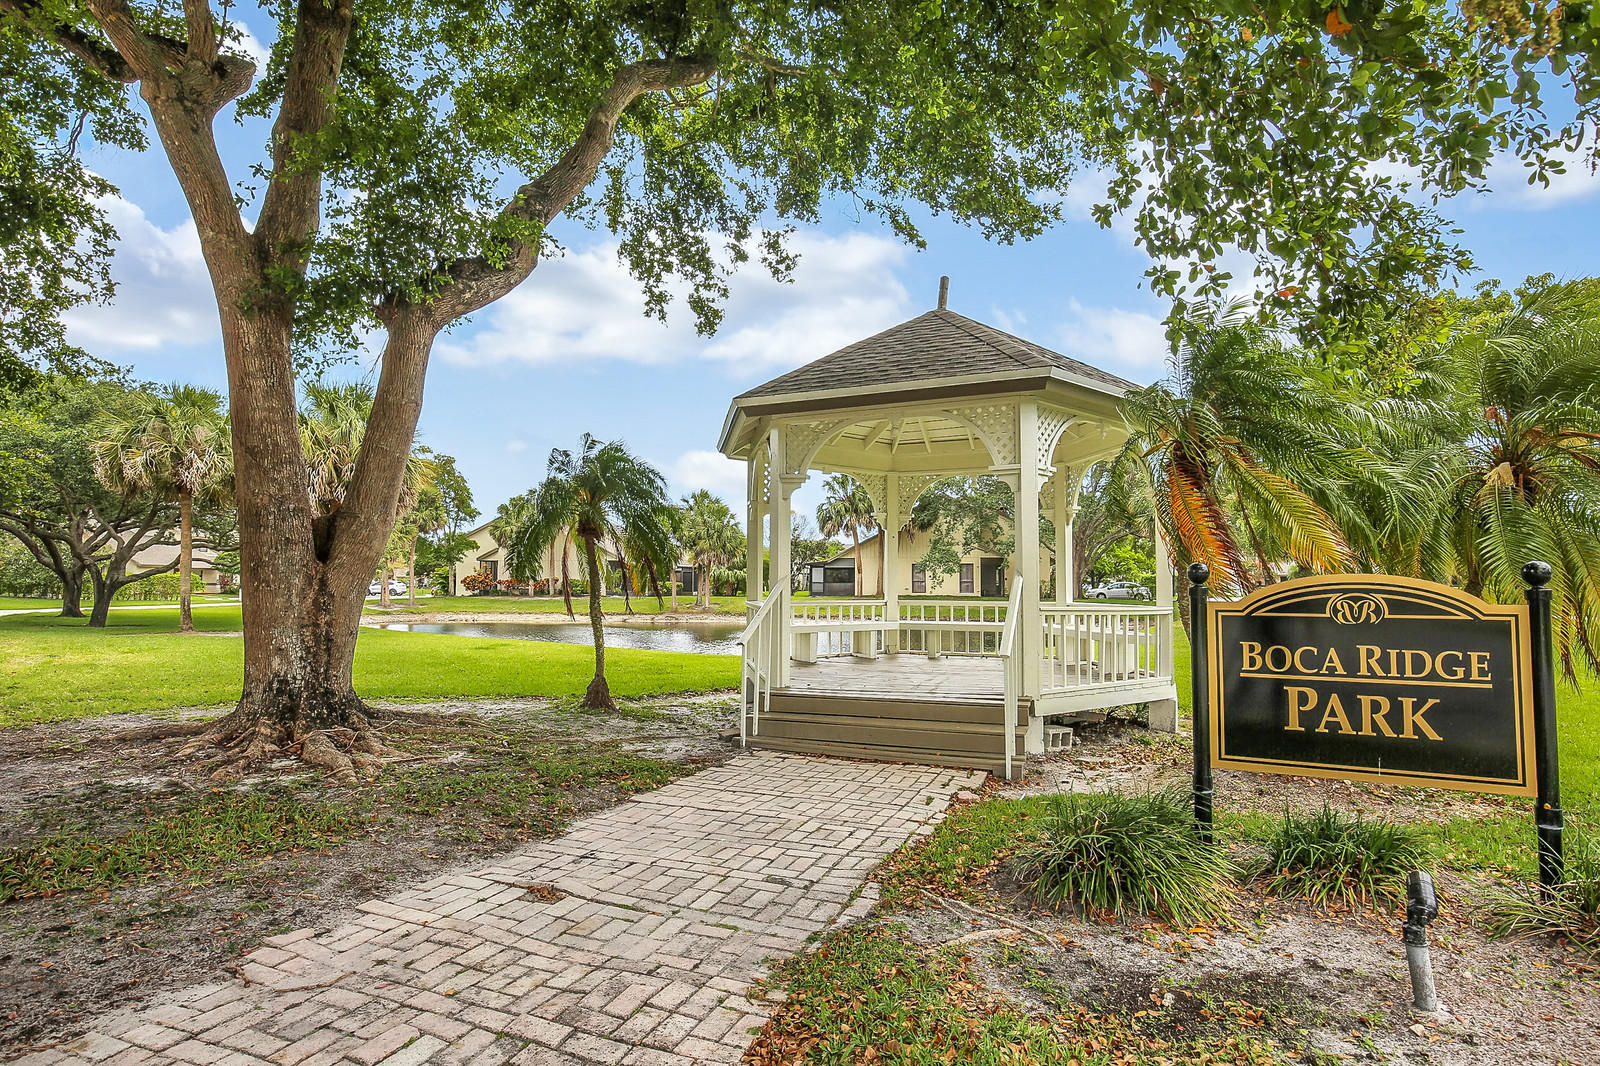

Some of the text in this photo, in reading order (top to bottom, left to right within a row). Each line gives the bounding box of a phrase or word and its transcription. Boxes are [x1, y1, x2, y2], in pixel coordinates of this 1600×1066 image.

[1239, 641, 1493, 681] BOCA RIDGE
[1283, 685, 1444, 741] PARK
